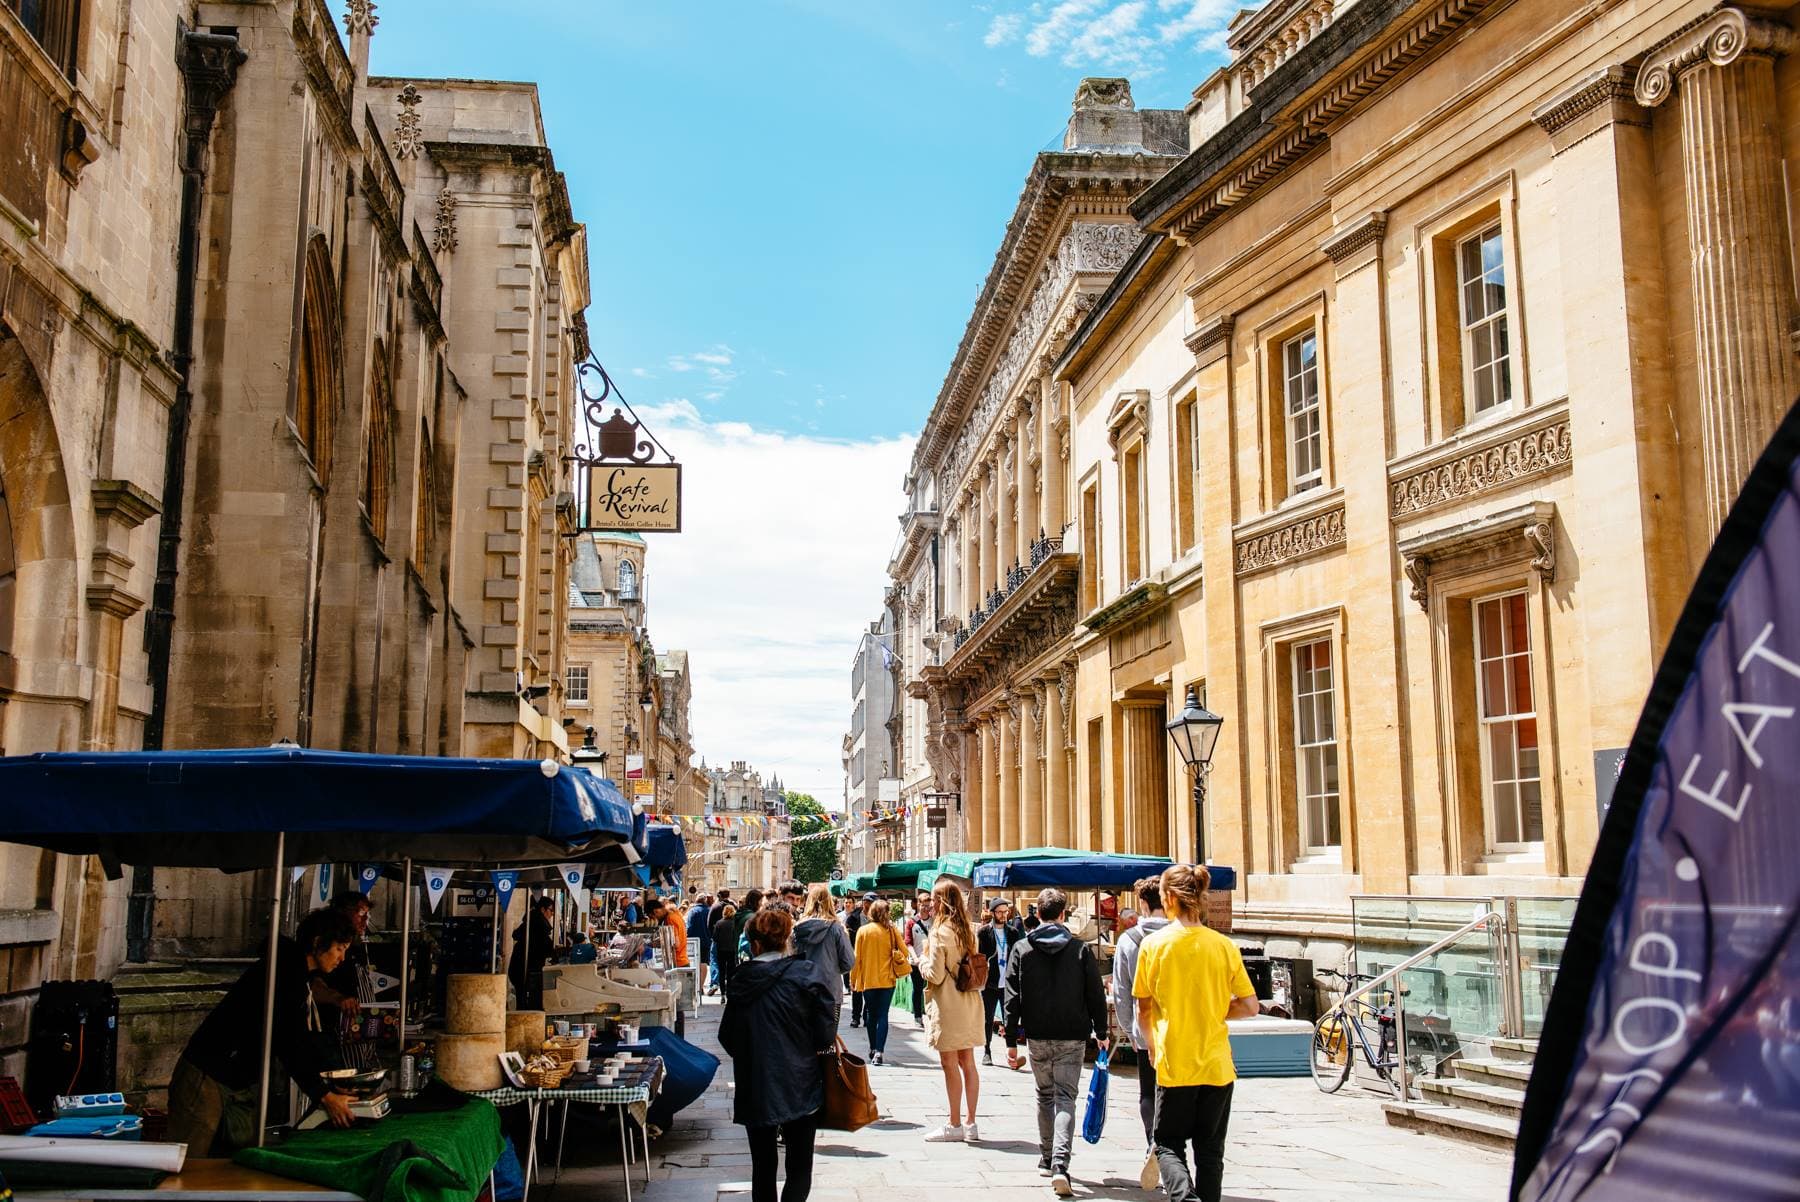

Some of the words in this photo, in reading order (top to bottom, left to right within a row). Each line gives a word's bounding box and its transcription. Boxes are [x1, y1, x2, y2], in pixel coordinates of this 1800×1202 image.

[607, 468, 649, 501] Cafe
[598, 494, 668, 520] Revival
[1678, 621, 1800, 822] EAT
